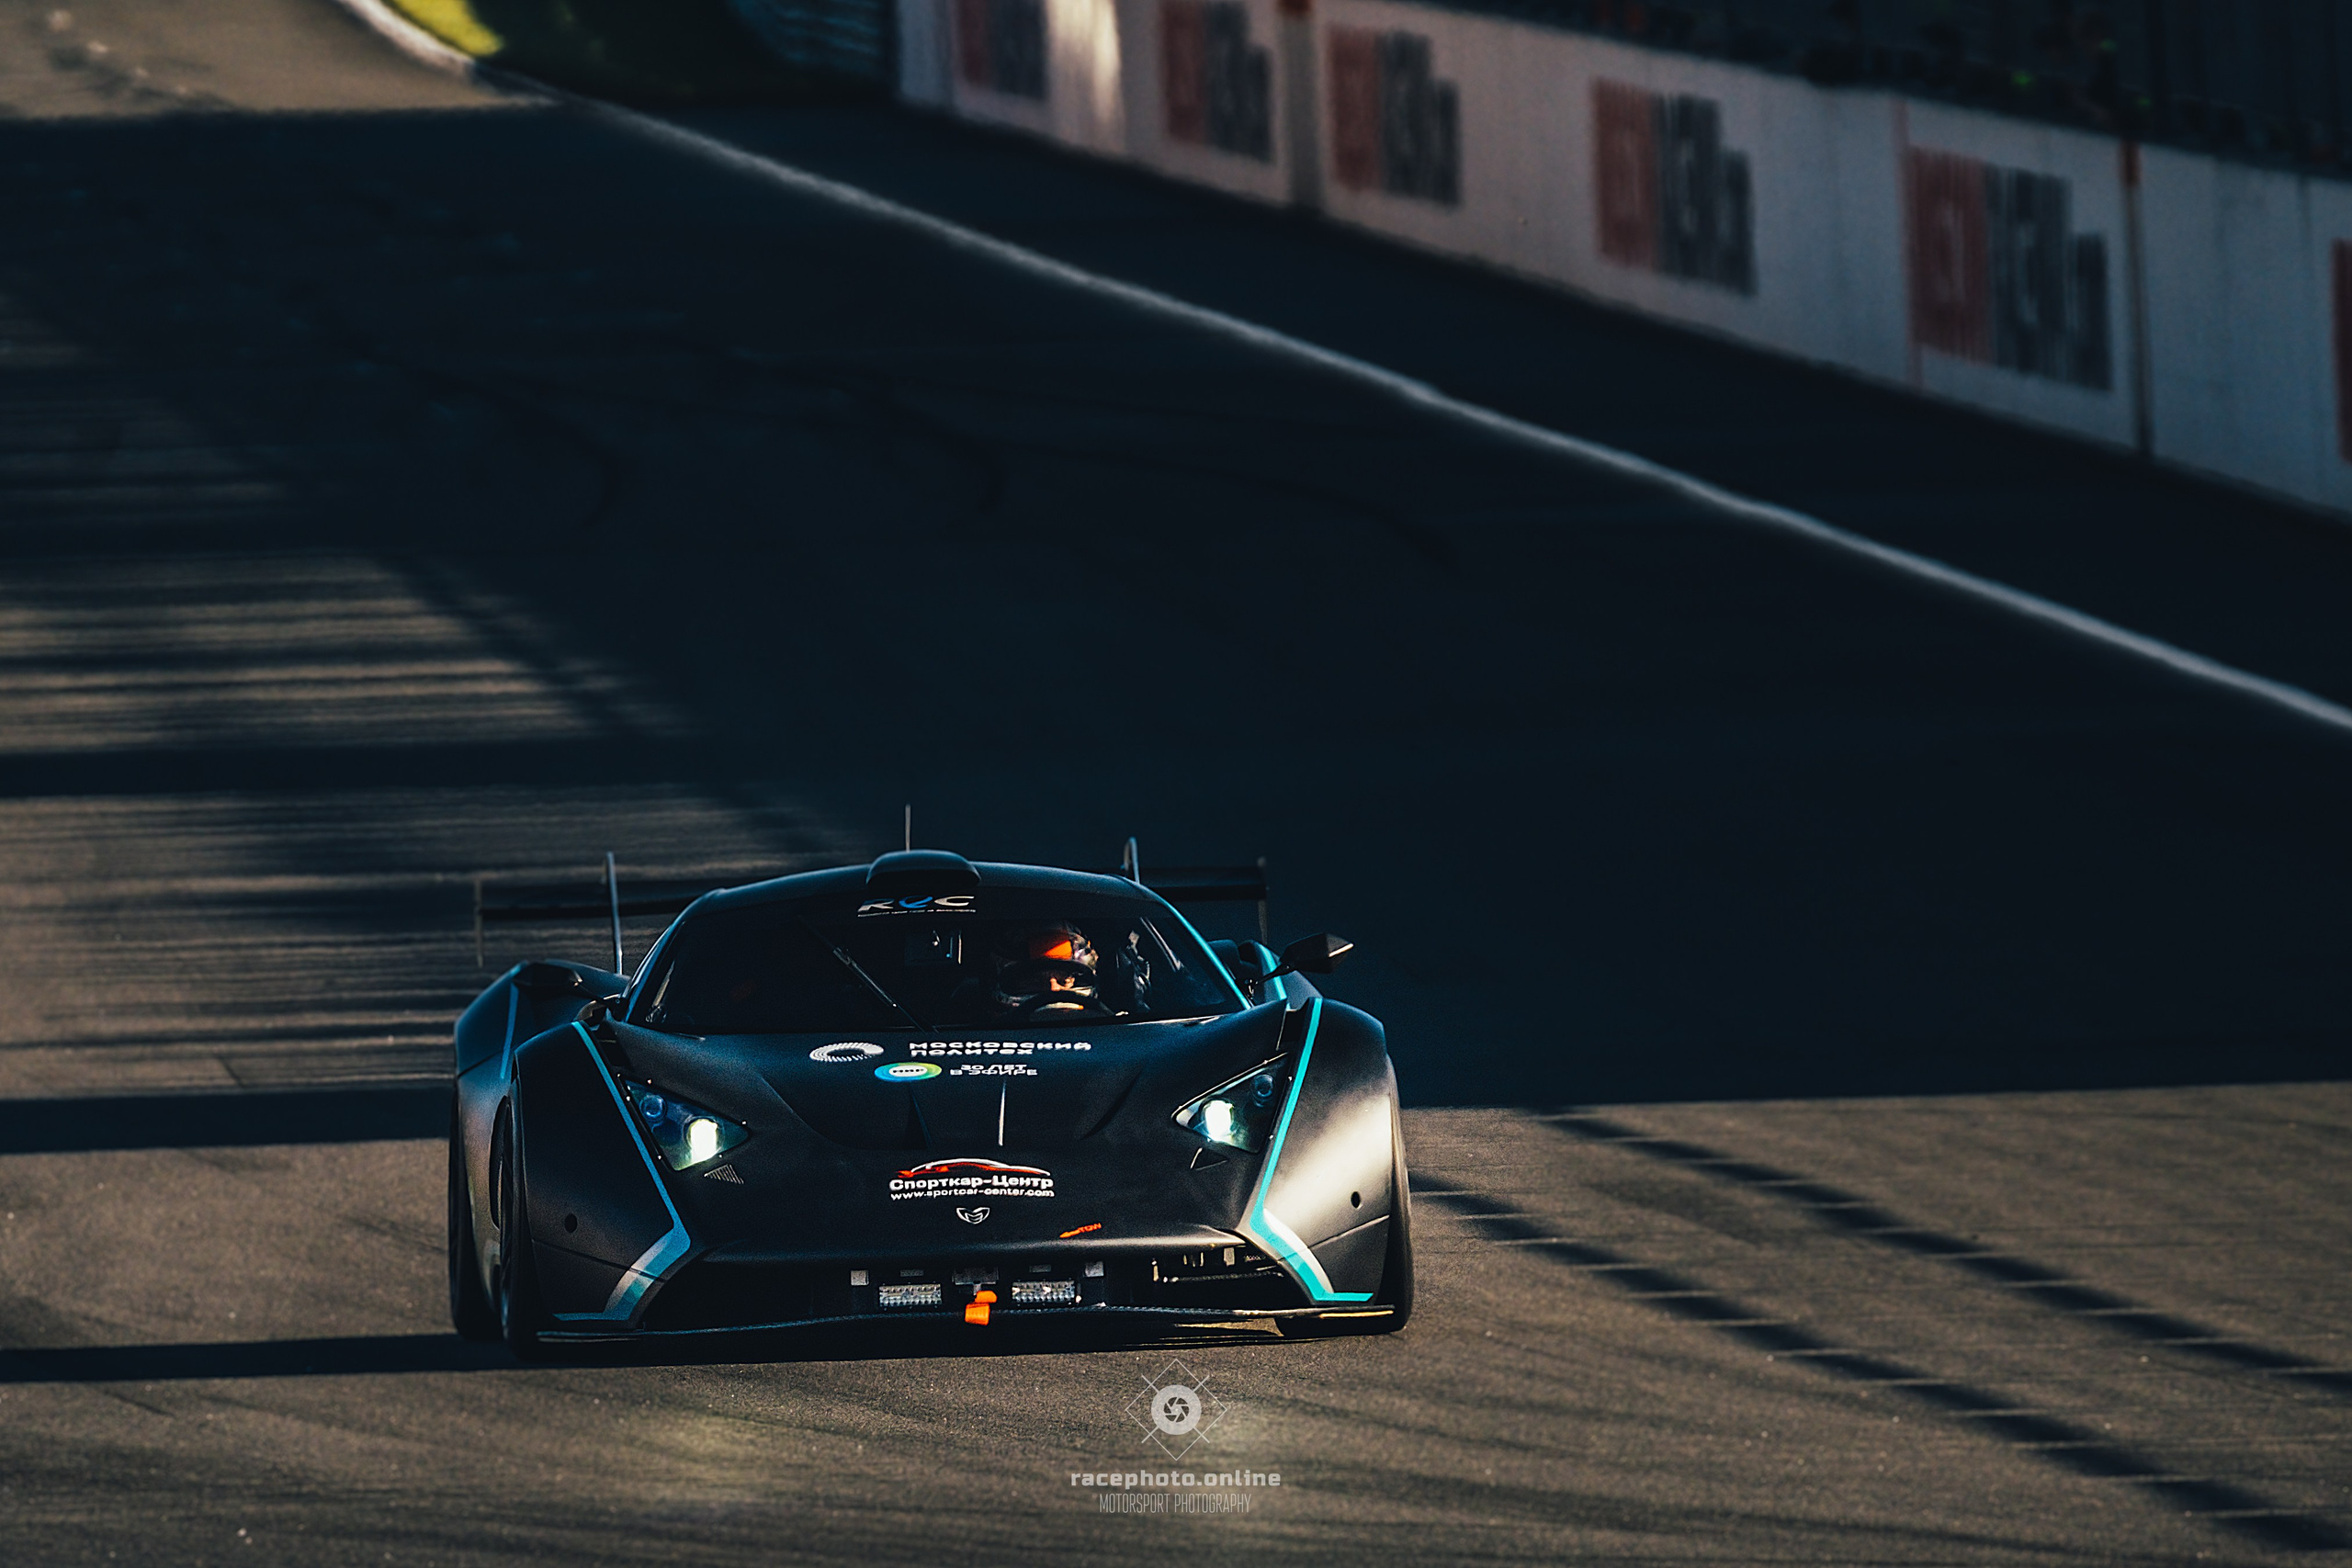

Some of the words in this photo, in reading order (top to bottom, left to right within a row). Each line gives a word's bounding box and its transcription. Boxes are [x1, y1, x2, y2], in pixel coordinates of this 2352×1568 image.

[909, 1042, 1091, 1052] МОСКОВСКИЙ
[889, 1175, 1054, 1190] Спорткар-Центр
[890, 1188, 1055, 1201] www.sportcar-center.com
